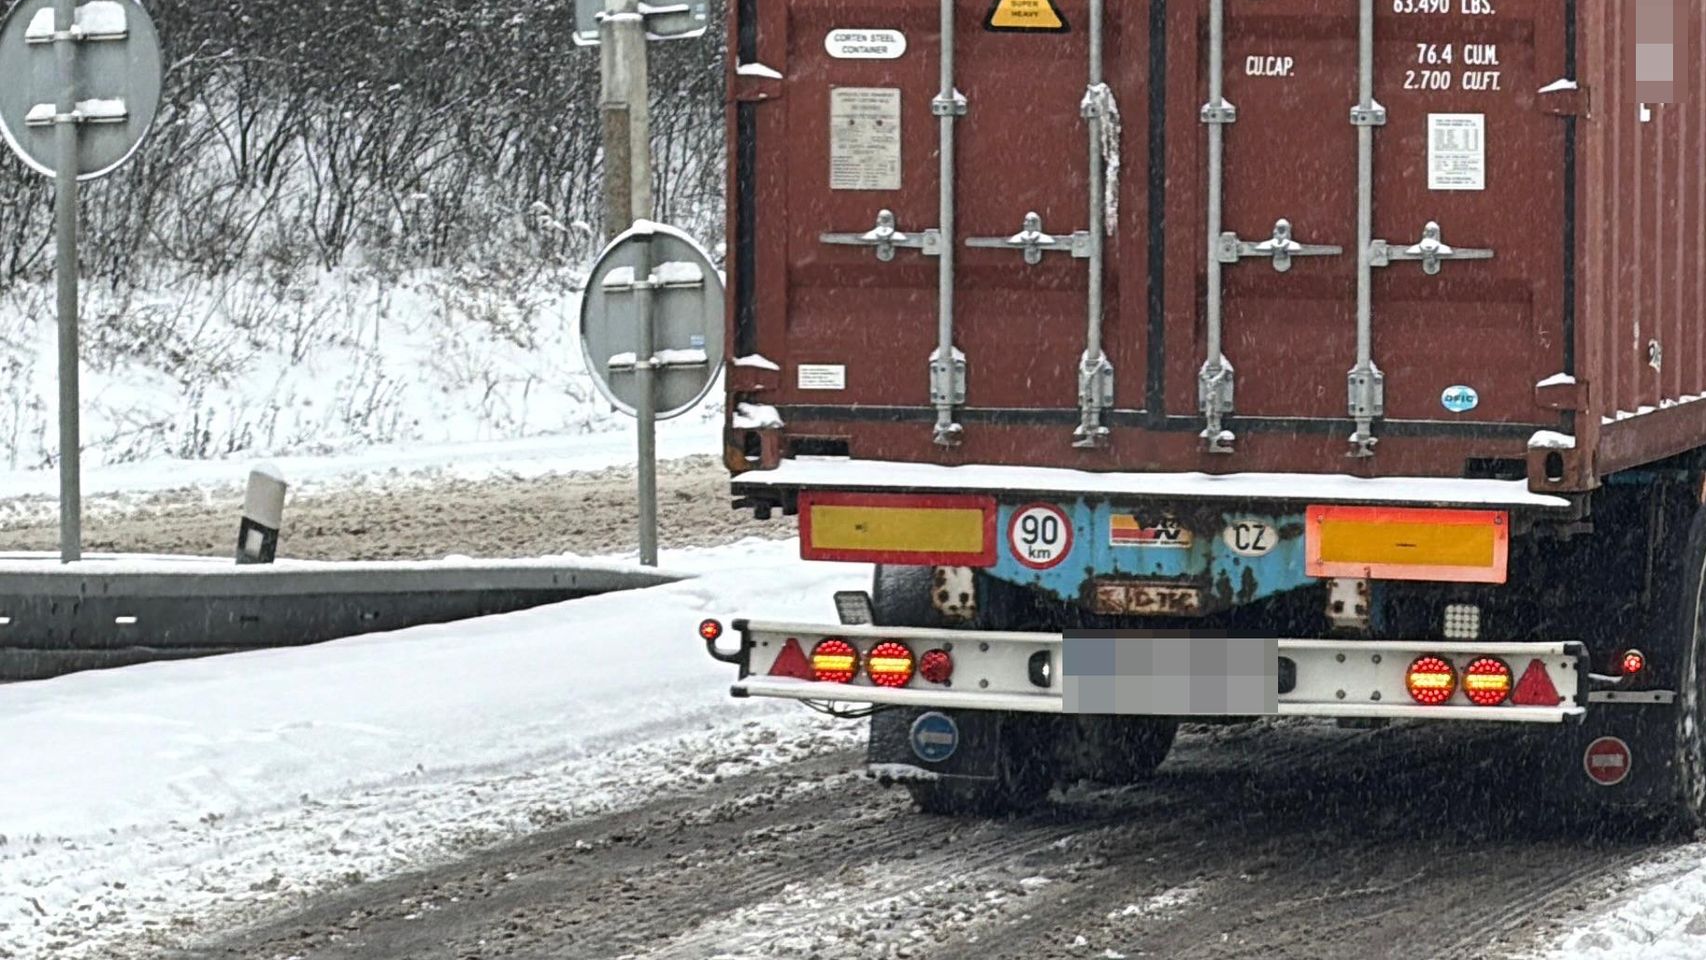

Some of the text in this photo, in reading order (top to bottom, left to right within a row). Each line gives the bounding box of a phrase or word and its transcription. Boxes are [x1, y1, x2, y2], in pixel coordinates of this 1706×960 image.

[1416, 43, 1452, 64] 76.4
[1245, 55, 1295, 76] CU.CAP.
[1403, 70, 1451, 90] 2.700
[1021, 514, 1059, 544] 90
[1234, 524, 1267, 551] CZ
[1027, 546, 1051, 560] km
